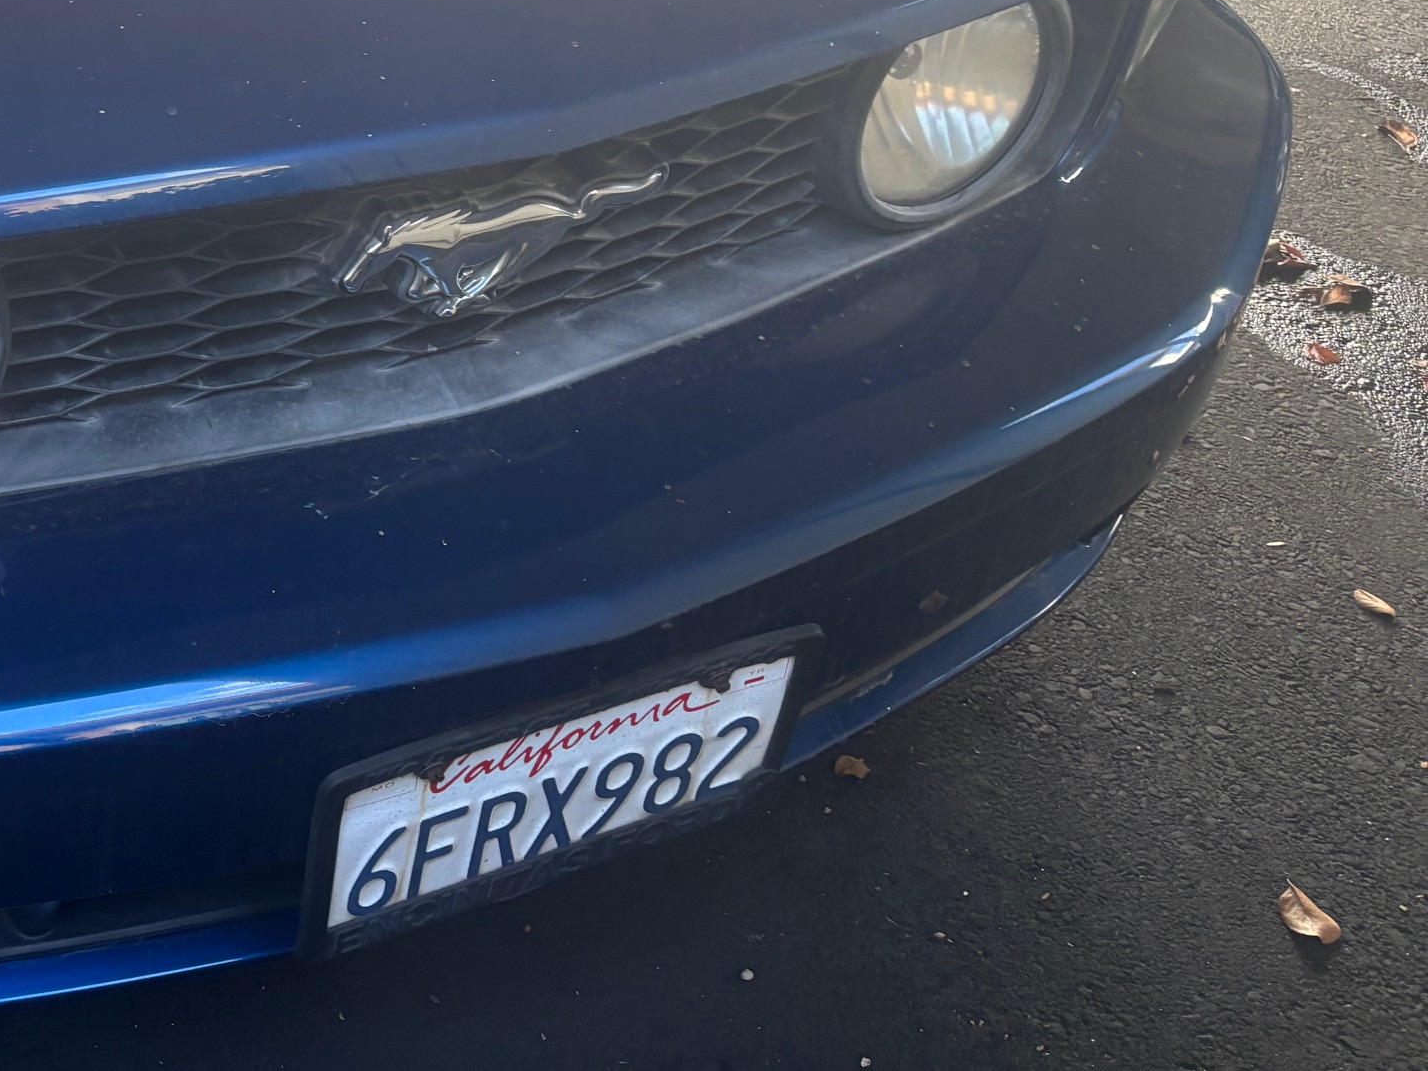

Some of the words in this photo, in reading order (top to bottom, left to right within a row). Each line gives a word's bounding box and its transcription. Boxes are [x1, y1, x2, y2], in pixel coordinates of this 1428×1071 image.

[748, 667, 766, 676] YR
[430, 692, 719, 794] California
[371, 781, 395, 793] MO
[347, 716, 759, 916] 6FRX982
